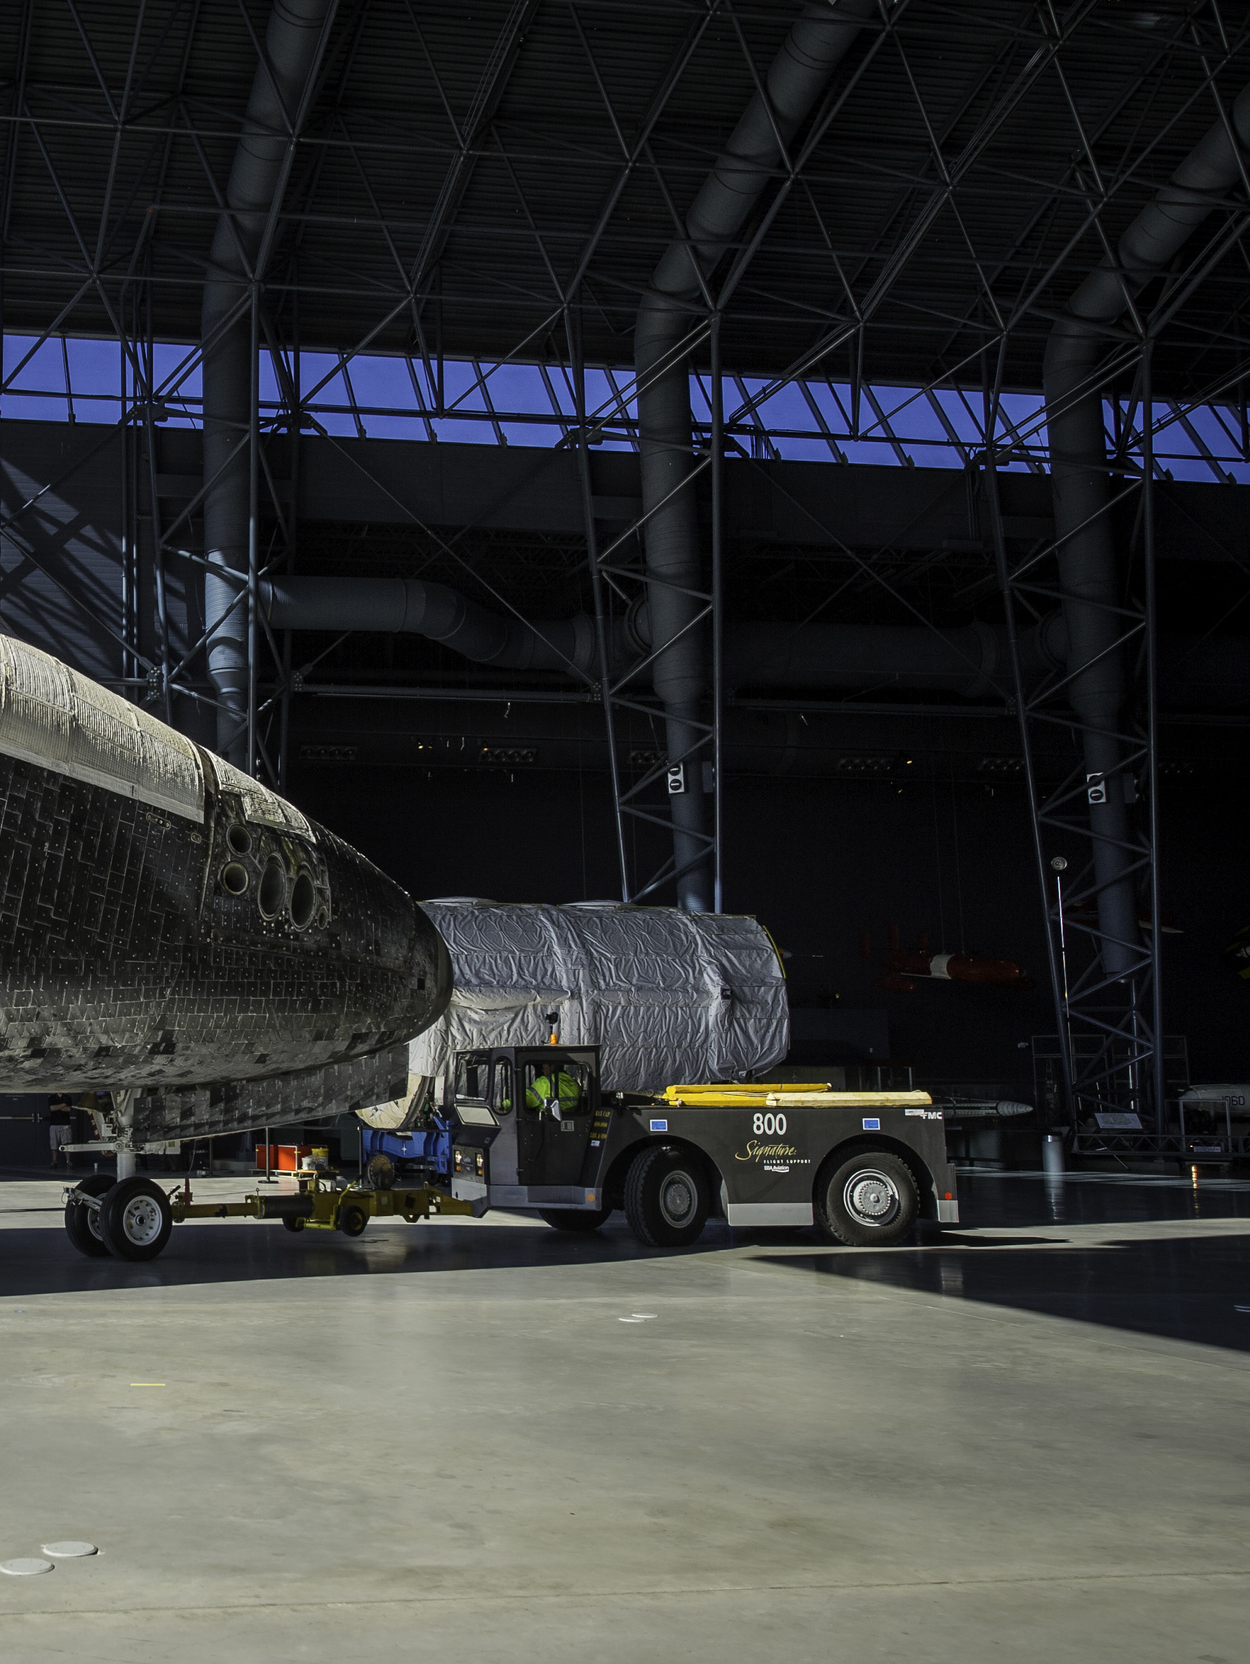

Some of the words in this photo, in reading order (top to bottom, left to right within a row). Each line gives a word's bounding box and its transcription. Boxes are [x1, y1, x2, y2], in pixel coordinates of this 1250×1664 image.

[753, 1113, 787, 1135] 800
[921, 1111, 943, 1119] FMC
[735, 1139, 796, 1163] Signature
